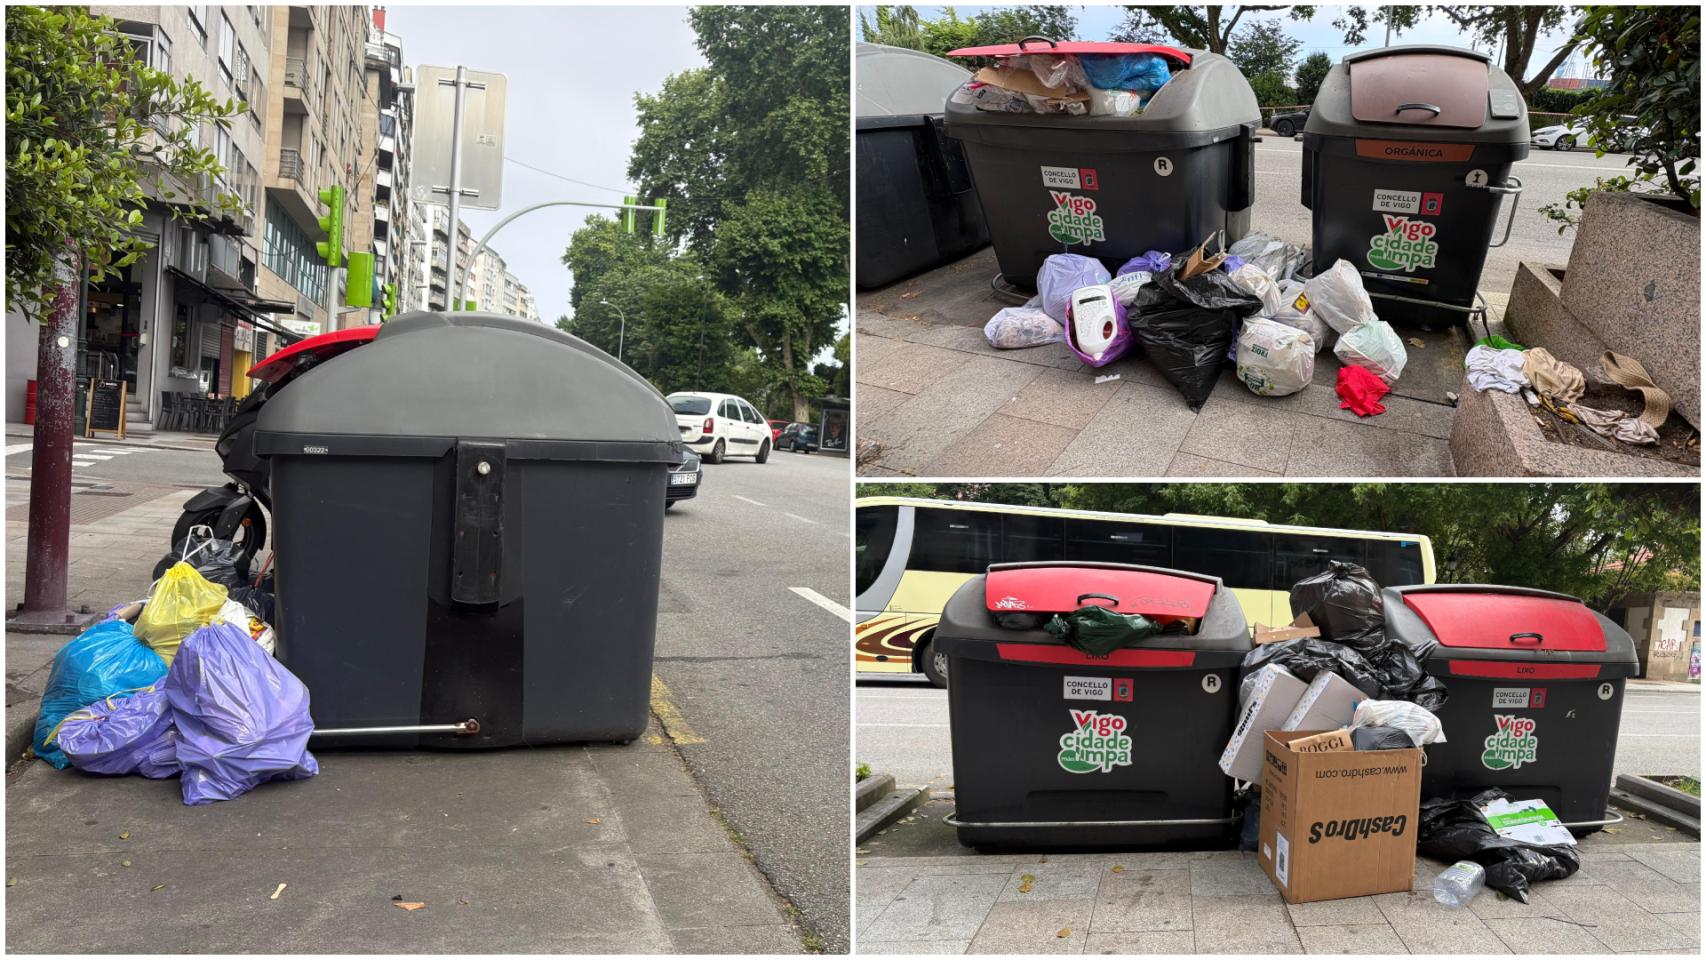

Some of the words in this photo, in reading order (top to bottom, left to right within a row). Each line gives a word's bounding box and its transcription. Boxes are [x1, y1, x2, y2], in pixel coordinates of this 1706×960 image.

[1385, 147, 1443, 158] ORGÁNICA
[1158, 160, 1167, 170] R
[1044, 170, 1076, 178] CONCELLO
[1054, 193, 1093, 215] Vigo
[1376, 193, 1417, 202] CONCELLO
[1050, 210, 1101, 228] cidade
[1387, 217, 1433, 241] Vigo
[1373, 233, 1436, 254] cidade
[1067, 680, 1108, 689] CONCELLO
[1207, 677, 1216, 687] R
[1602, 685, 1610, 695] R
[1075, 713, 1124, 736] Vigo
[1498, 717, 1533, 737] Vigo
[1063, 729, 1130, 750] cidade
[1487, 731, 1535, 749] cidade
[1315, 765, 1408, 779] www.cashdro.com
